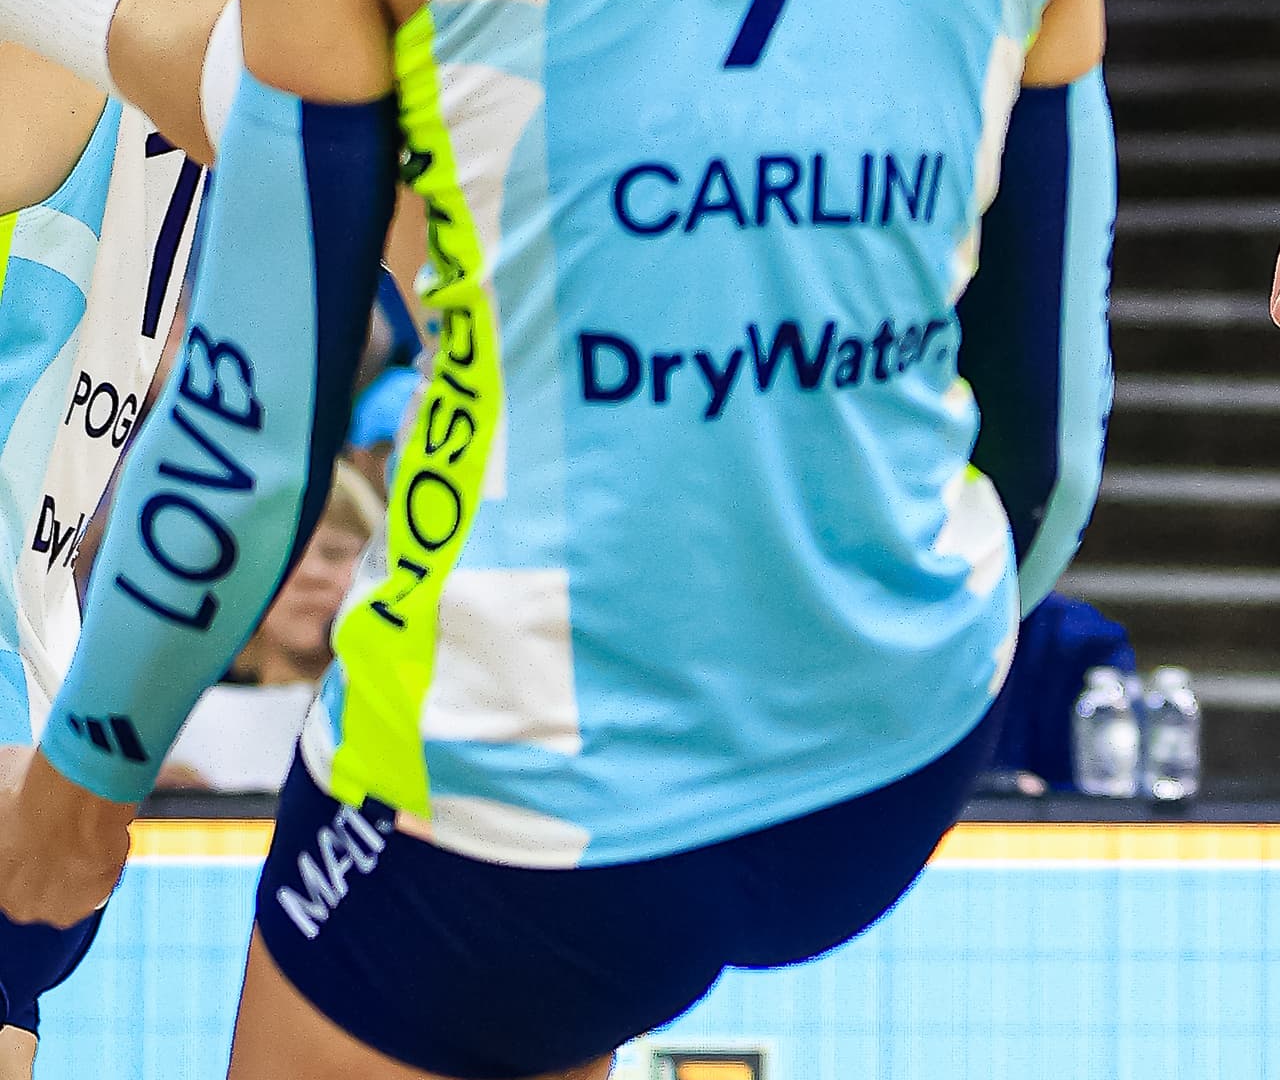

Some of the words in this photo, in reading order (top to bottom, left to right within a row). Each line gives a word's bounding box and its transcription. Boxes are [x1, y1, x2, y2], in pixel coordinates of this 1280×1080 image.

[612, 152, 947, 238] CARLINI
[65, 369, 138, 450] POG
[115, 324, 265, 633] LOVB
